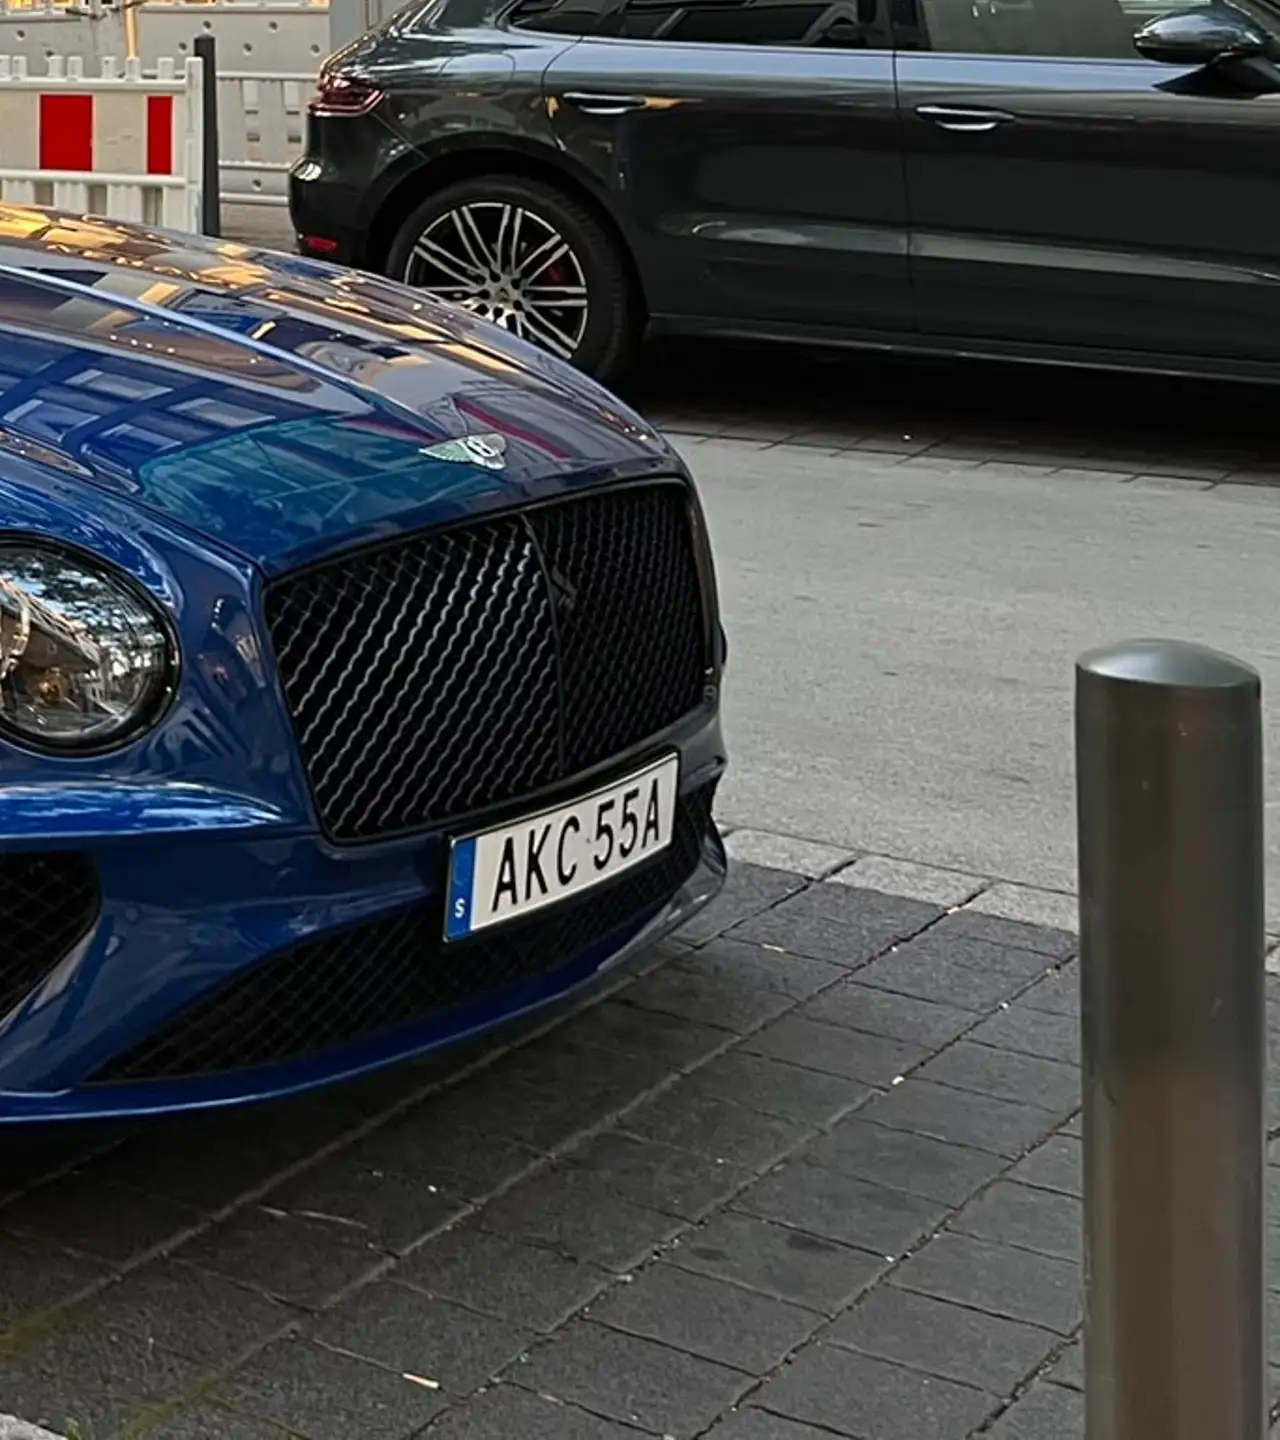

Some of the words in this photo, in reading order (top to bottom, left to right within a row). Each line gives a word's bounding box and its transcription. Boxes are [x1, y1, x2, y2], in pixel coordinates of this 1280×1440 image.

[492, 814, 580, 913] AKC
[593, 778, 660, 871] 55A
[454, 897, 466, 919] S
